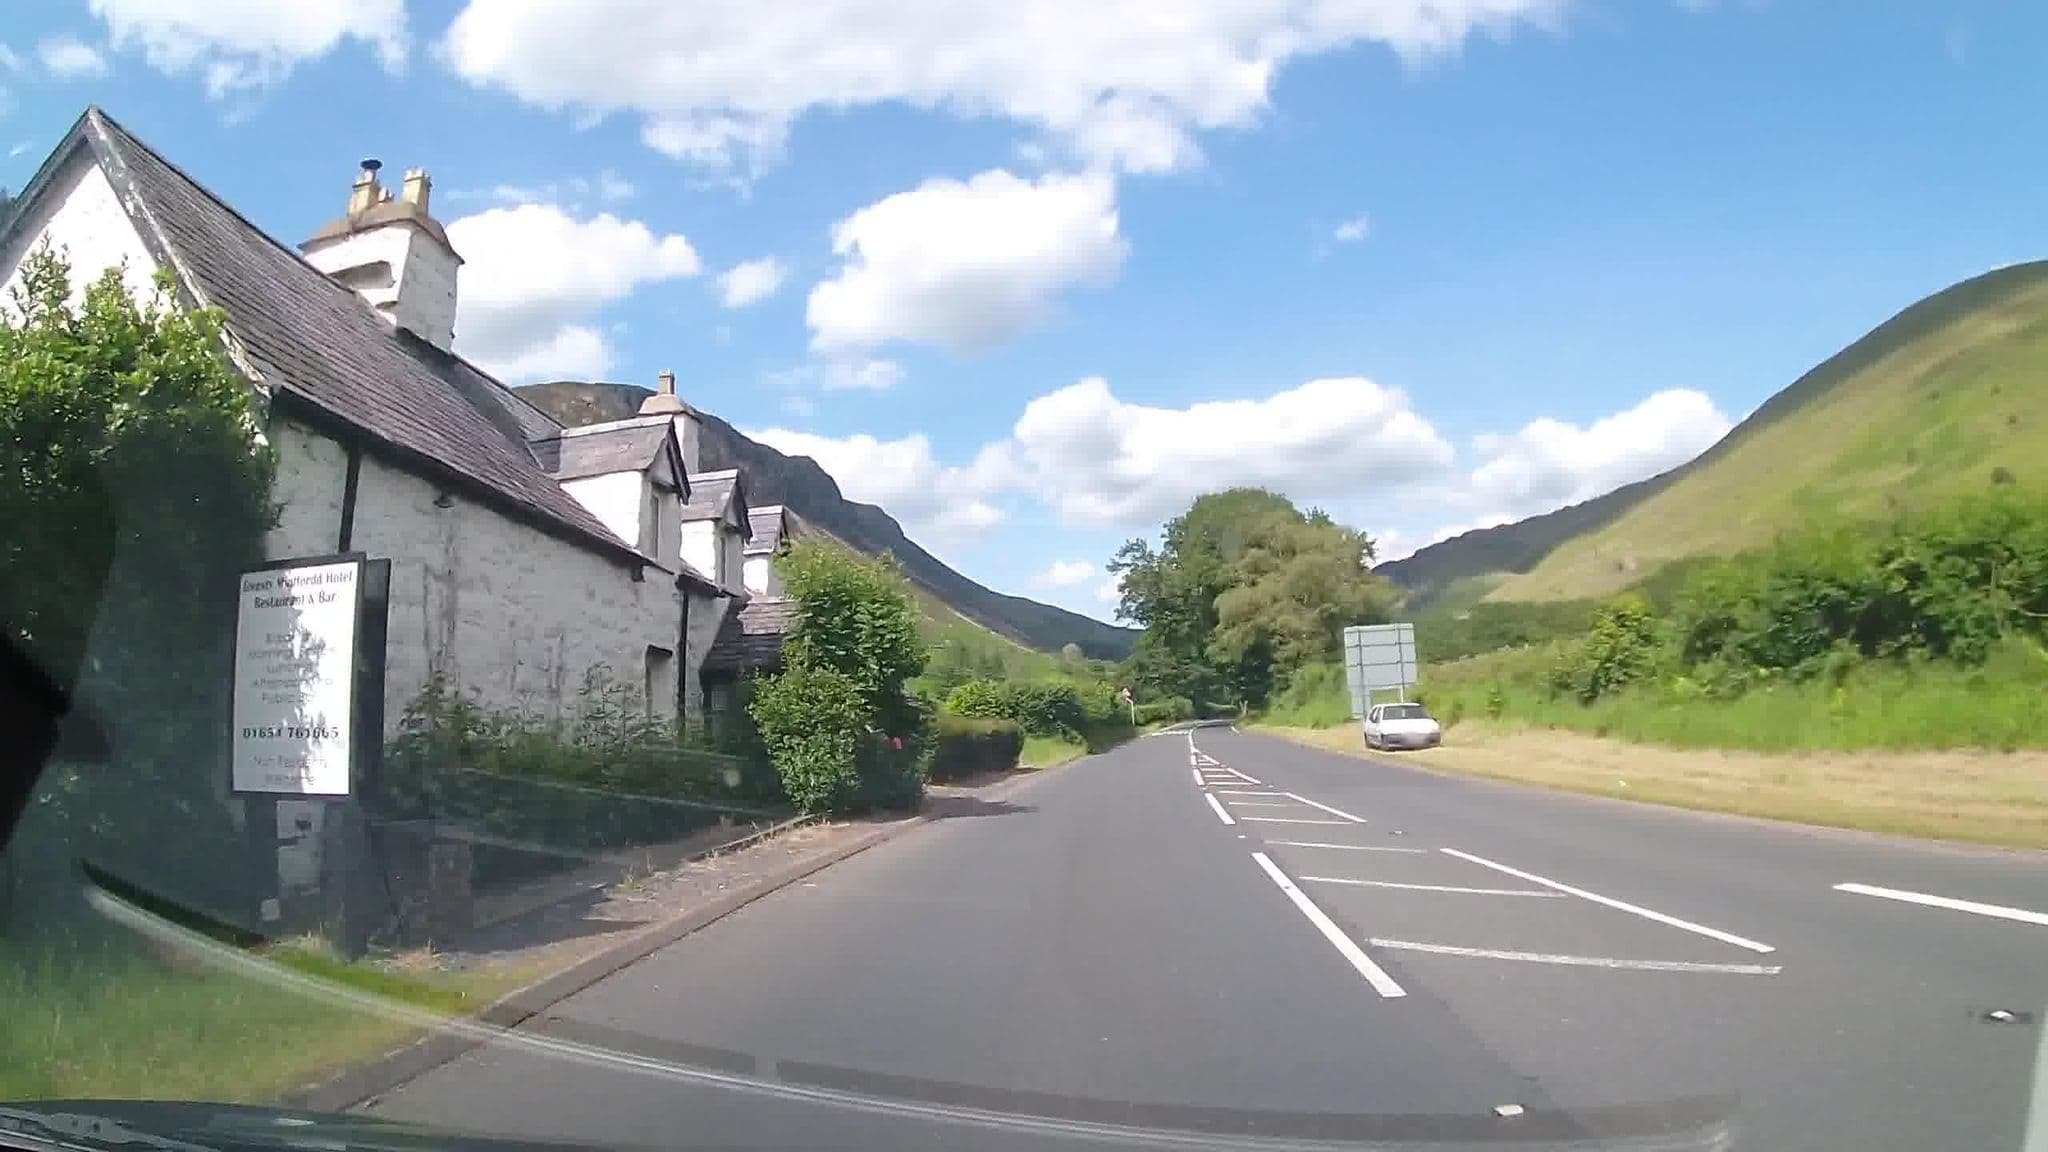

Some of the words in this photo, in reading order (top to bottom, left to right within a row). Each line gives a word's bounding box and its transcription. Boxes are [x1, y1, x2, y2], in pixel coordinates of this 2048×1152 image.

[326, 570, 353, 584] Hotel
[255, 594, 305, 609] Restaurant
[308, 594, 314, 605] &
[318, 590, 337, 604] Bar
[243, 727, 282, 739] 01654
